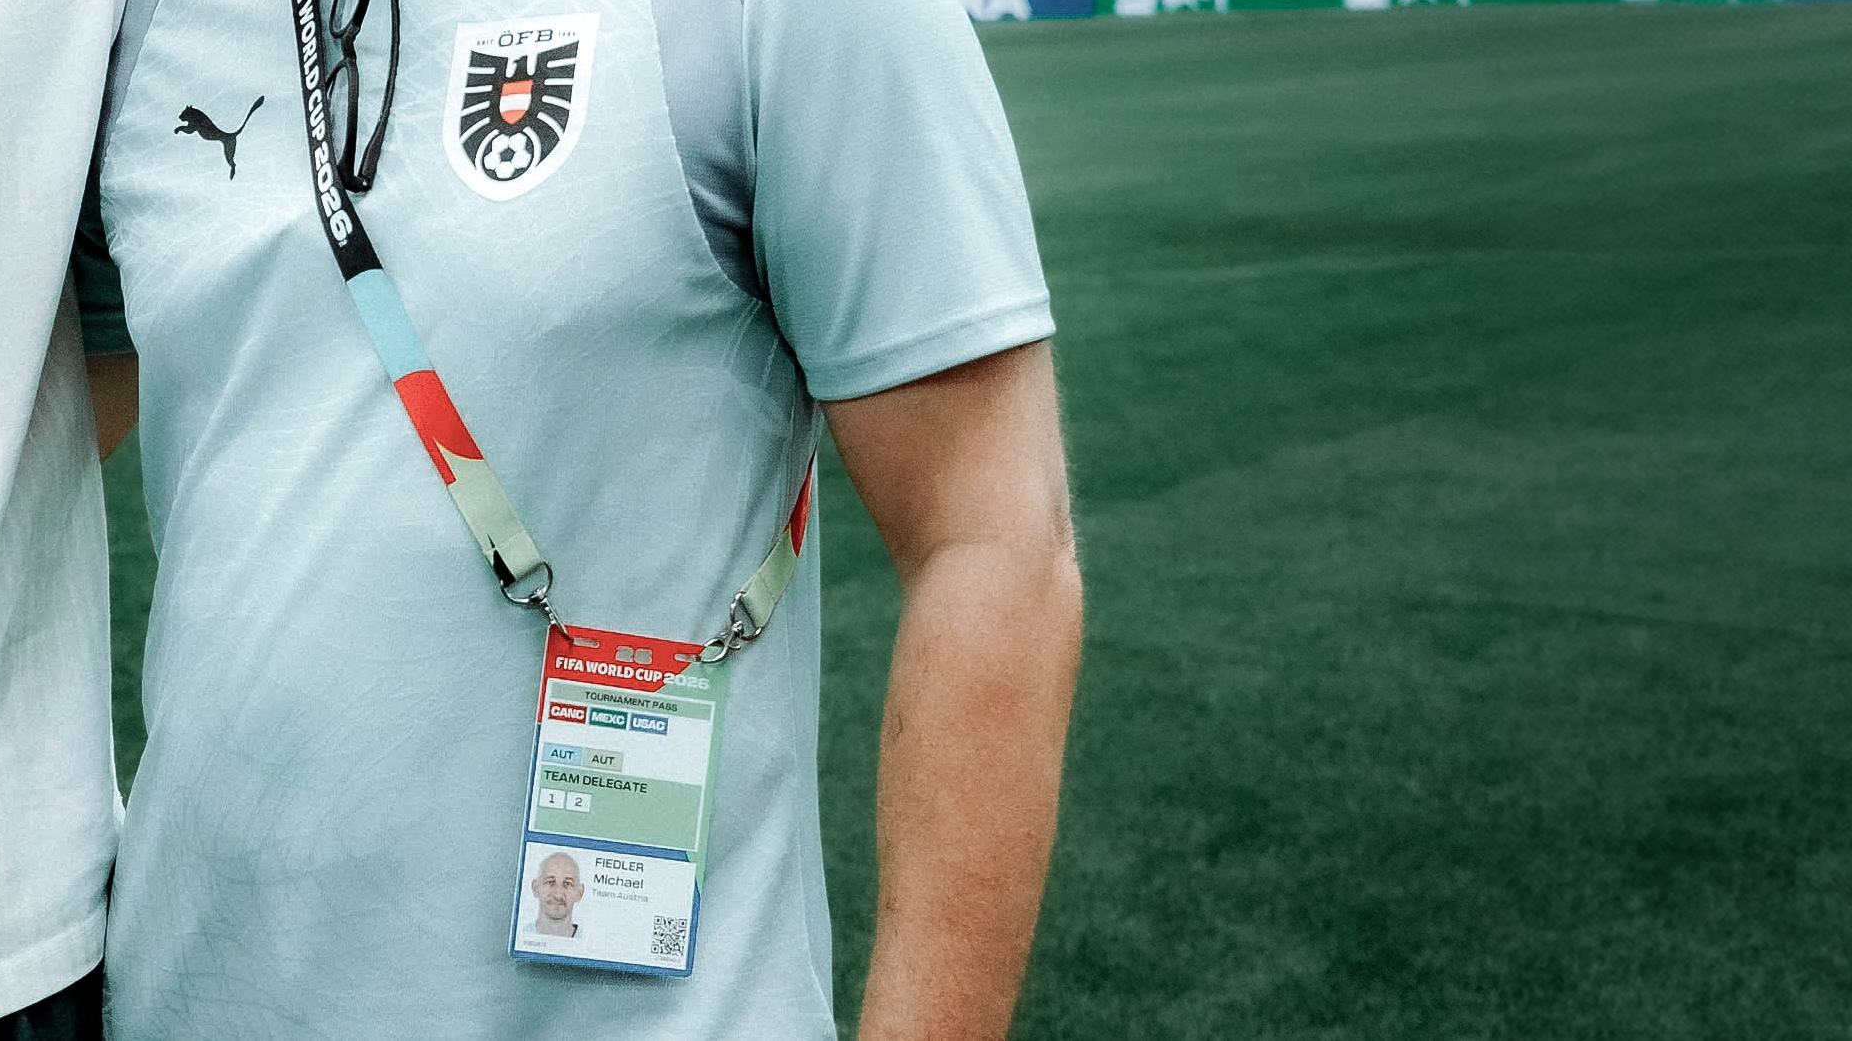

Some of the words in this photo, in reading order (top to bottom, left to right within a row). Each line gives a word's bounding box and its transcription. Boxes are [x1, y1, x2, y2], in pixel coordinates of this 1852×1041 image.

[498, 28, 554, 48] ÖFB
[308, 88, 326, 141] CUP
[314, 140, 354, 242] 2026
[555, 656, 585, 672] FIFA
[586, 661, 635, 679] WORLD
[635, 669, 663, 684] CUP
[663, 672, 710, 690] 2026
[585, 691, 652, 709] TOURNAMENT
[653, 701, 678, 712] PASS
[551, 748, 574, 760] AUT
[592, 754, 615, 765] AUT
[544, 770, 580, 785] TEAM
[582, 775, 648, 794] DELEGATE
[549, 793, 555, 804] 1
[575, 797, 583, 807] 2
[595, 857, 644, 872] FIEDLER
[593, 874, 644, 889] Michael
